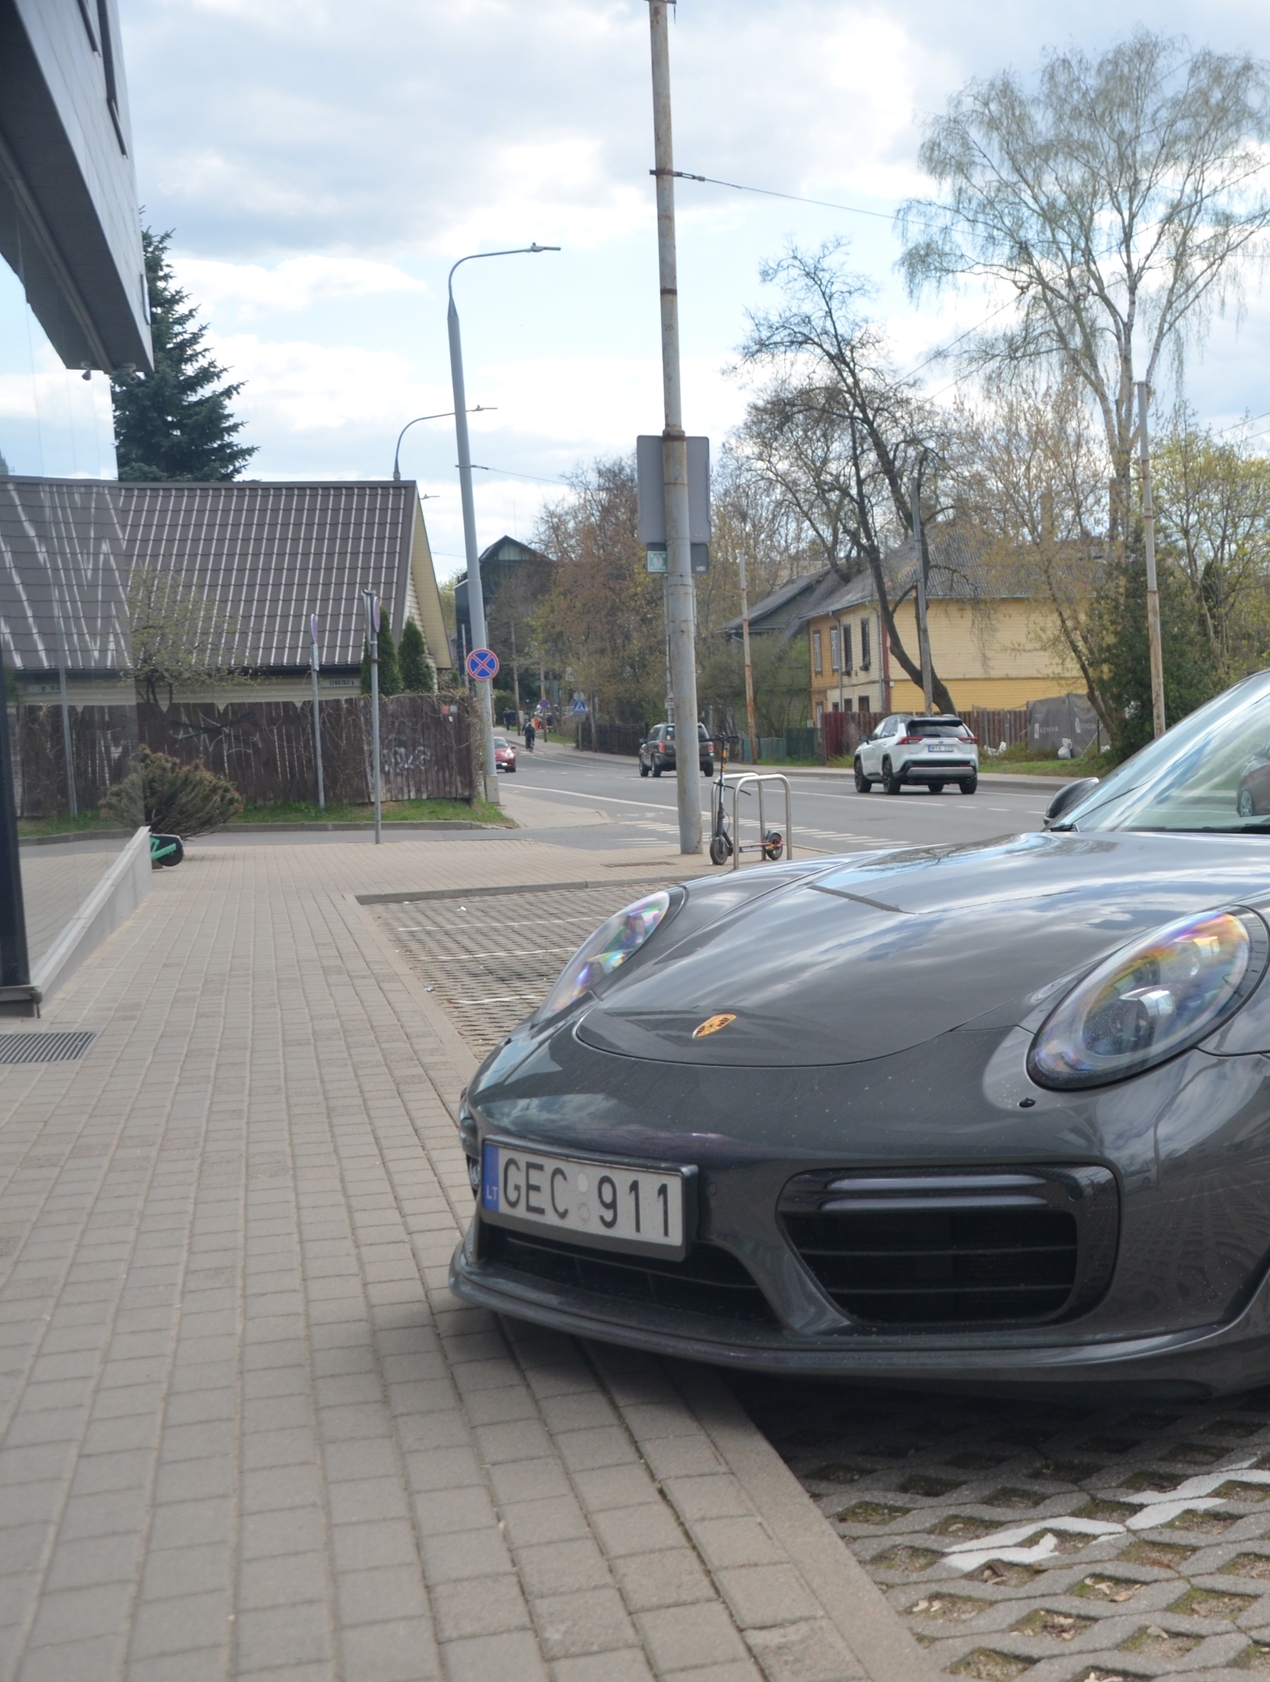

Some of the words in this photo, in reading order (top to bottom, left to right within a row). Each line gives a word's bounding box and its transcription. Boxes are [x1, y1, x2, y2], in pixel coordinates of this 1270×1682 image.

[486, 1184, 499, 1200] LT
[503, 1157, 569, 1219] GEC
[597, 1174, 670, 1238] 911
